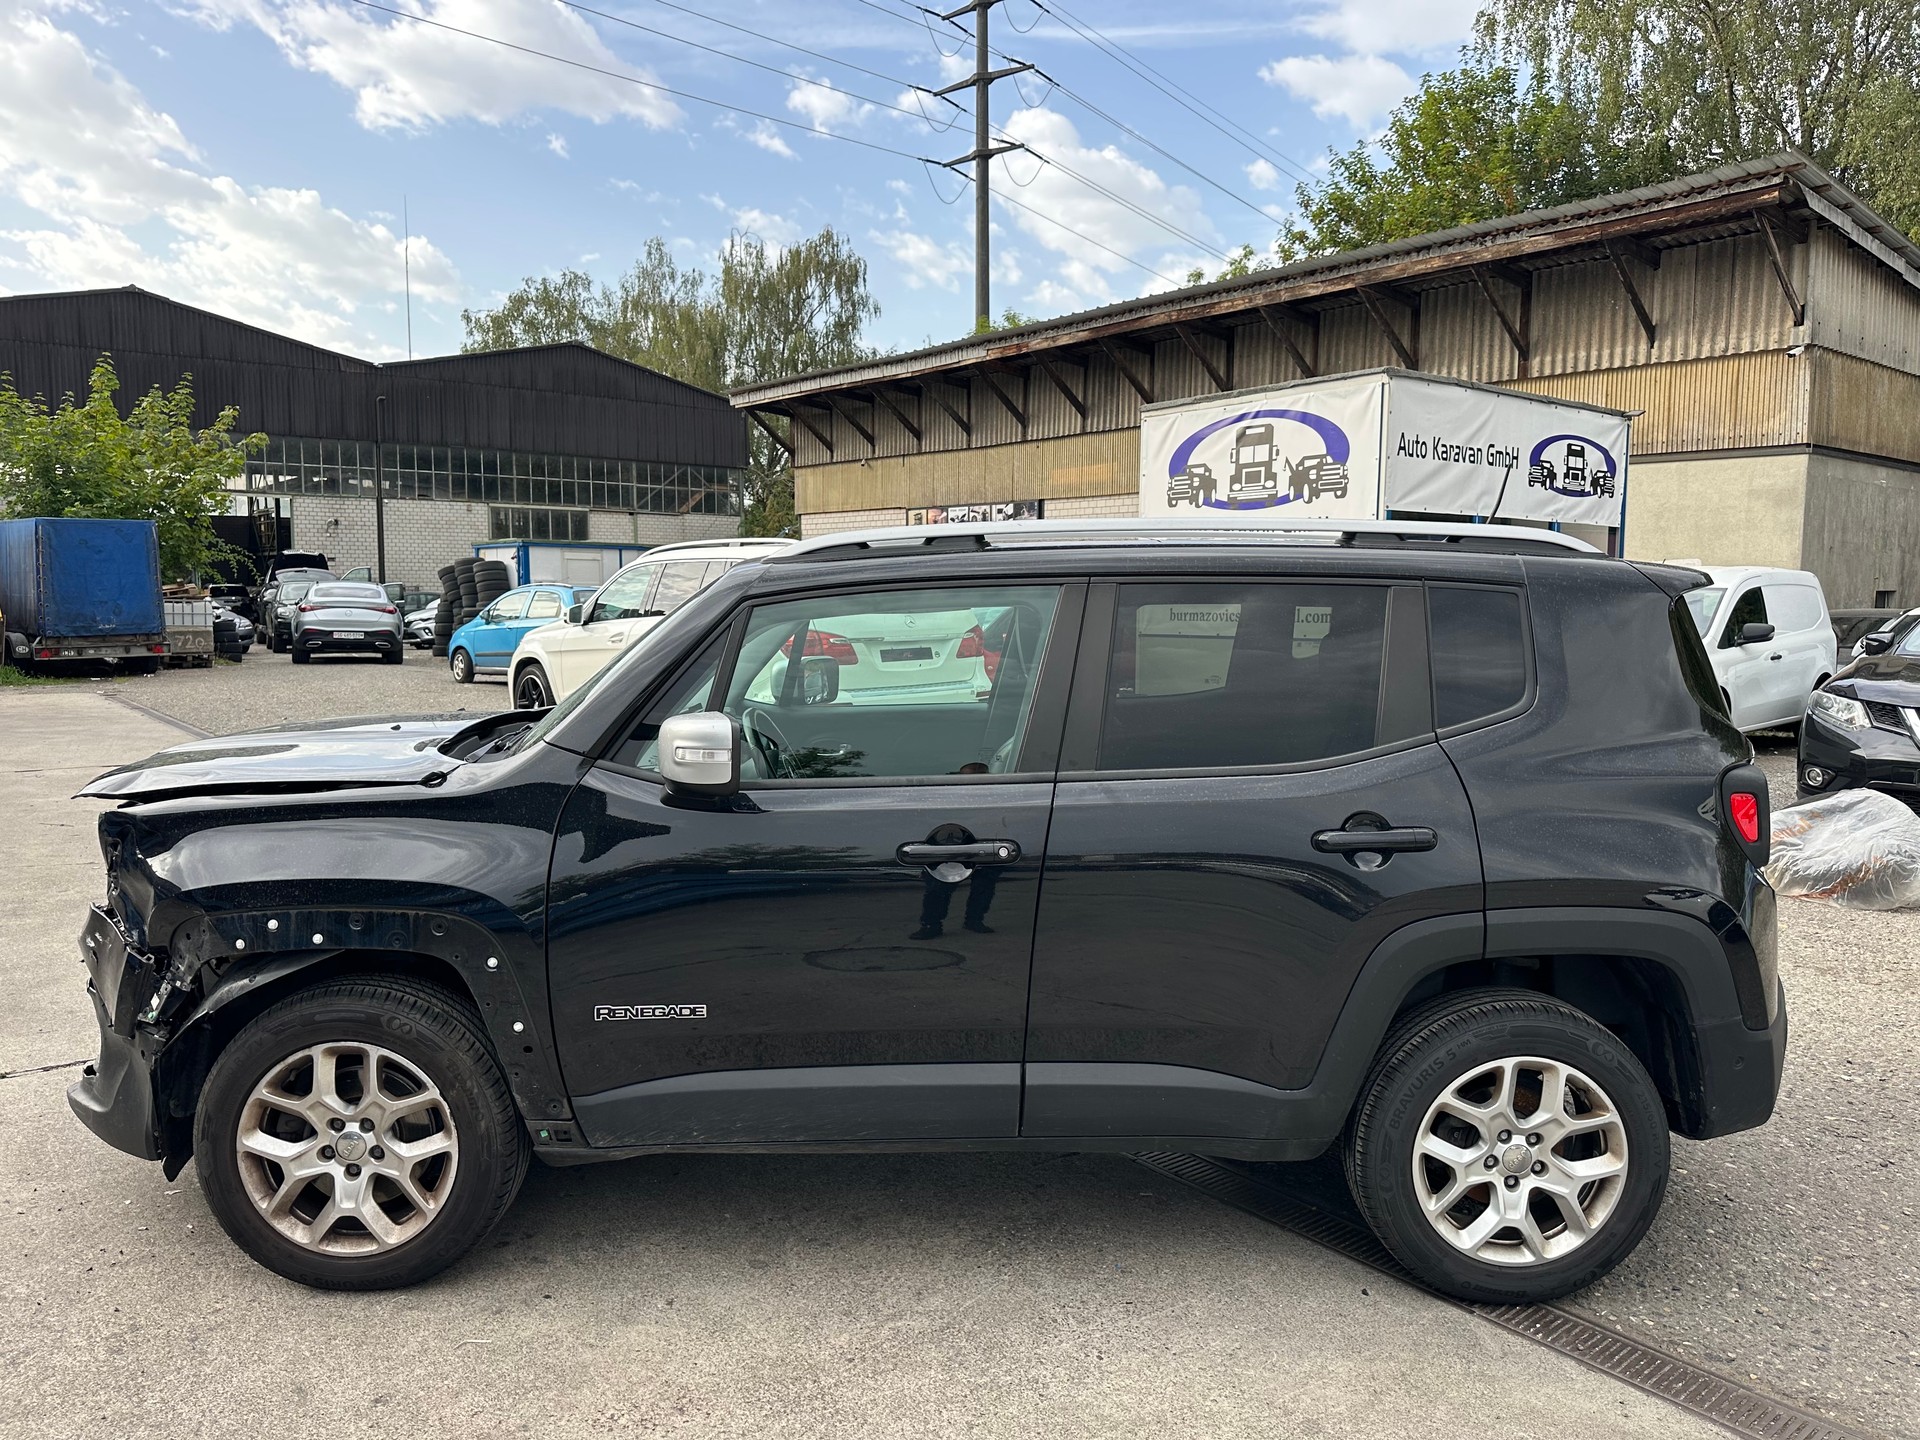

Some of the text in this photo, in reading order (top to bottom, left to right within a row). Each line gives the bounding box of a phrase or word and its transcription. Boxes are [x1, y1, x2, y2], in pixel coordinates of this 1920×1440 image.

[1396, 431, 1520, 470] Auto Karavan GmbH
[594, 1004, 707, 1021] RENEGADE
[1389, 1057, 1445, 1129] BRAVURIS
